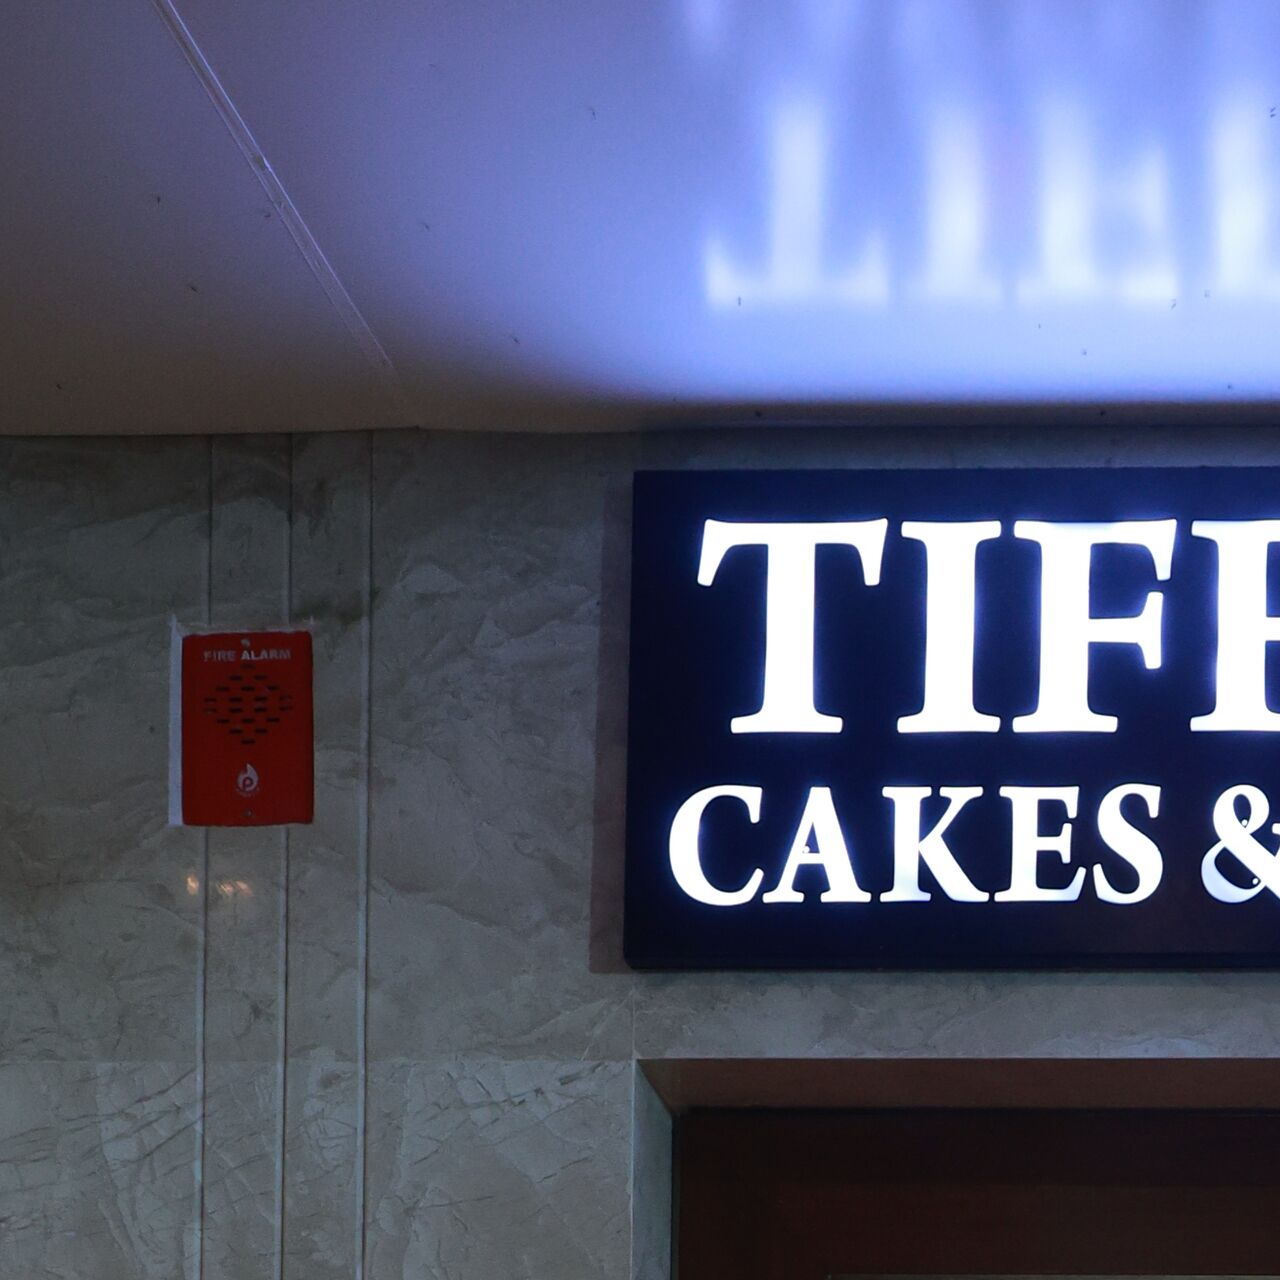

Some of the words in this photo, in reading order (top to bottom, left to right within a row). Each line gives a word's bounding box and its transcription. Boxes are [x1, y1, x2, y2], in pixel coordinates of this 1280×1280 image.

[203, 650, 237, 662] FIRE
[240, 649, 291, 660] ALARM
[670, 784, 1162, 905] CAKES
